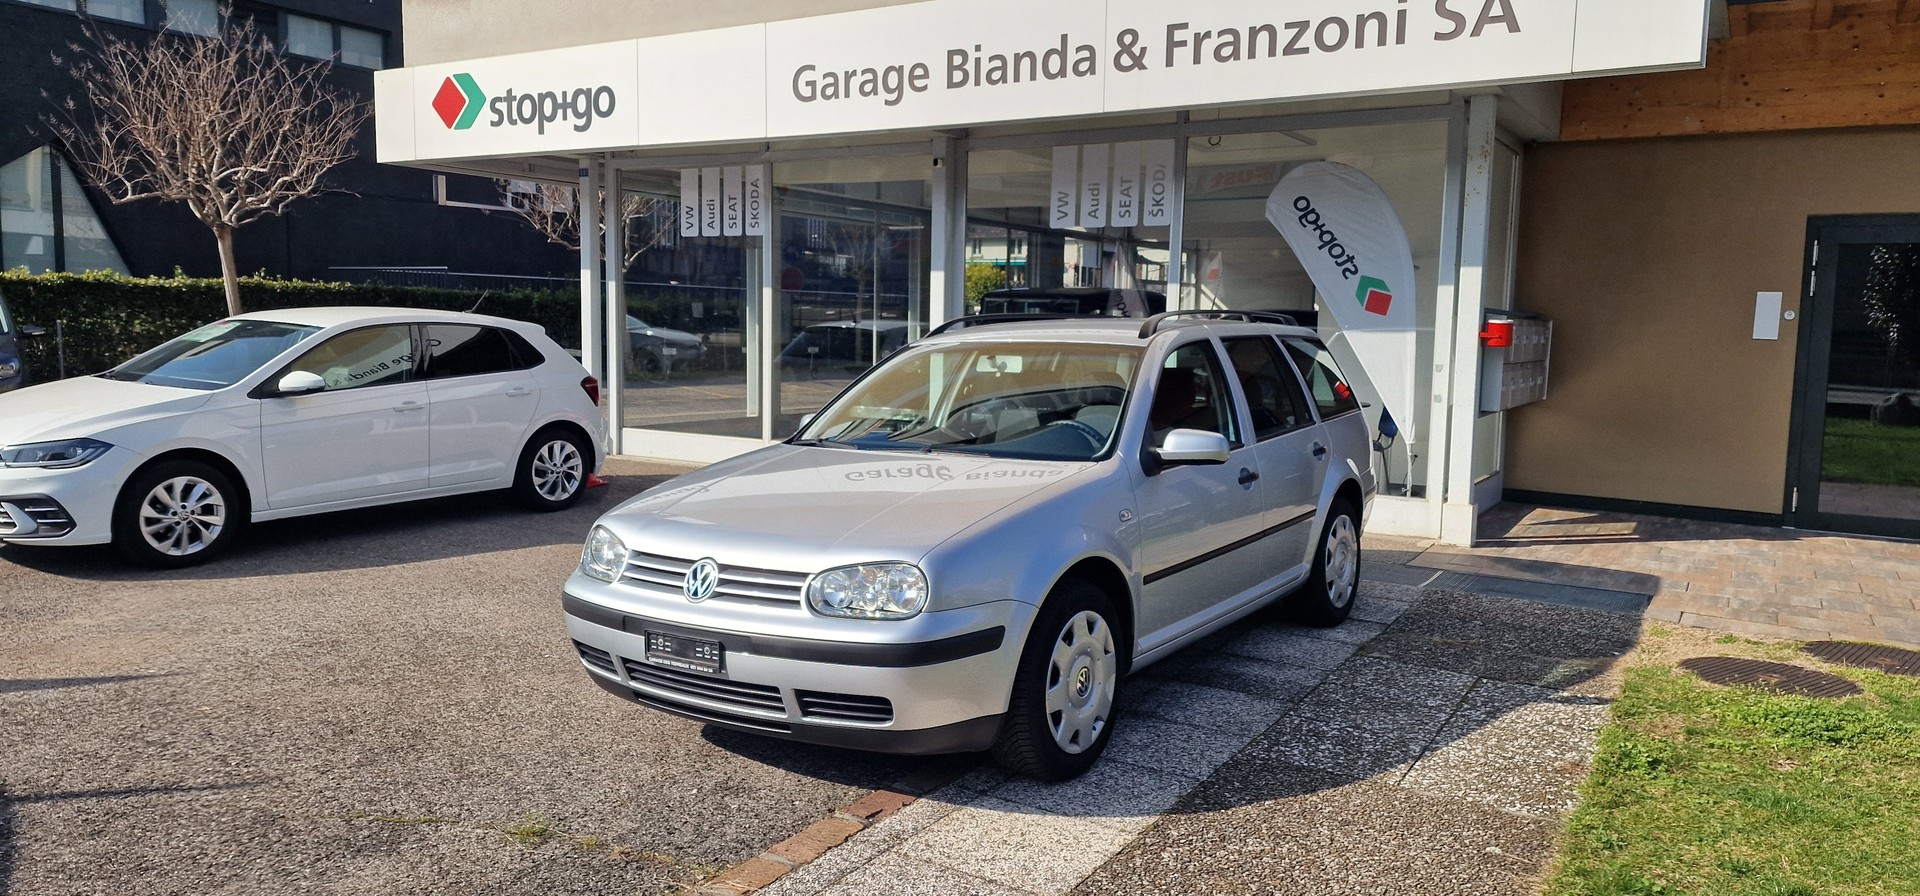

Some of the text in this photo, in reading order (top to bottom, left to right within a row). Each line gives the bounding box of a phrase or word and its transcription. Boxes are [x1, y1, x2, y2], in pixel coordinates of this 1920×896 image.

[792, 0, 1522, 106] Garage Bianda & Franzoni SA
[489, 85, 616, 135] stop+go
[706, 199, 715, 229] Audi
[728, 194, 738, 229] SEAT
[748, 178, 760, 229] ŠKODA
[1057, 191, 1069, 220] VW
[1087, 182, 1101, 220] Audi
[1118, 176, 1133, 219] SEAT
[685, 206, 694, 230] VW
